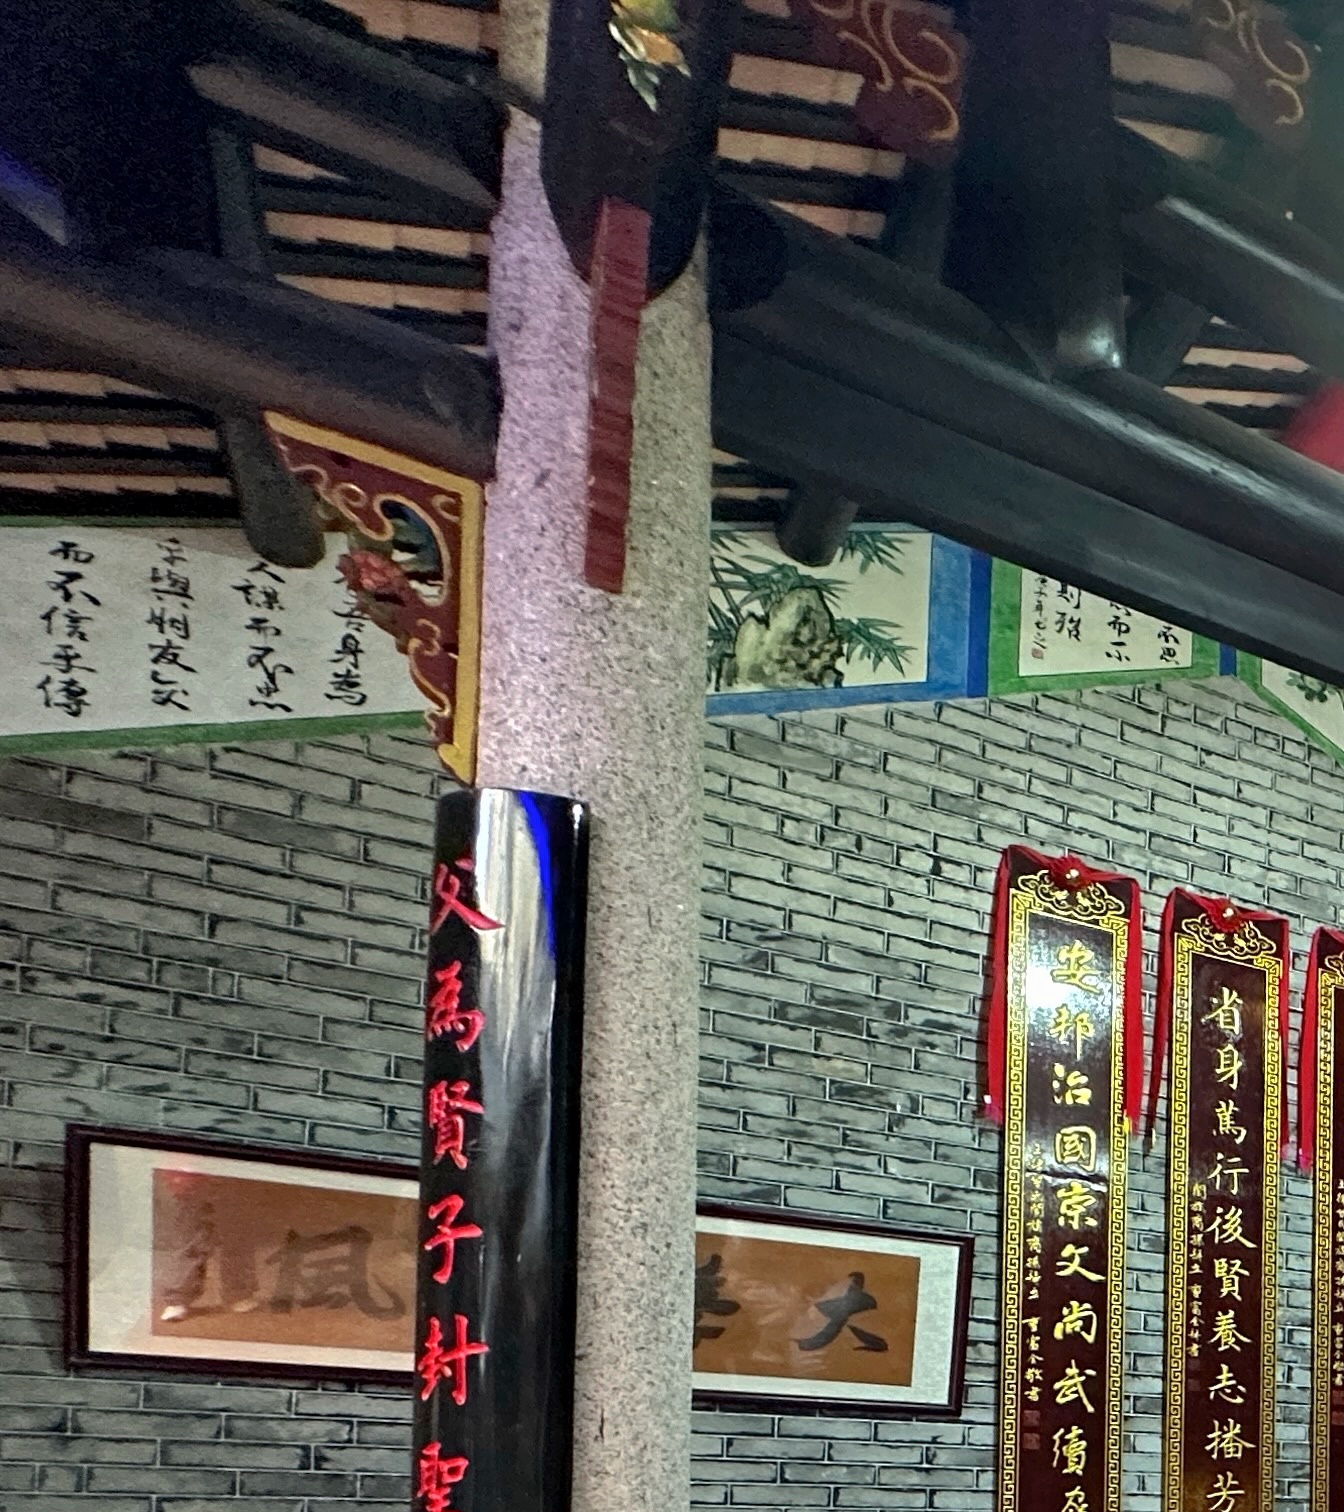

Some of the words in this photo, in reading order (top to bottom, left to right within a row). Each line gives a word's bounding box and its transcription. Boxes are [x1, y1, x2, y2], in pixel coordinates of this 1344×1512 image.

[35, 540, 100, 719] 而不信乎傳
